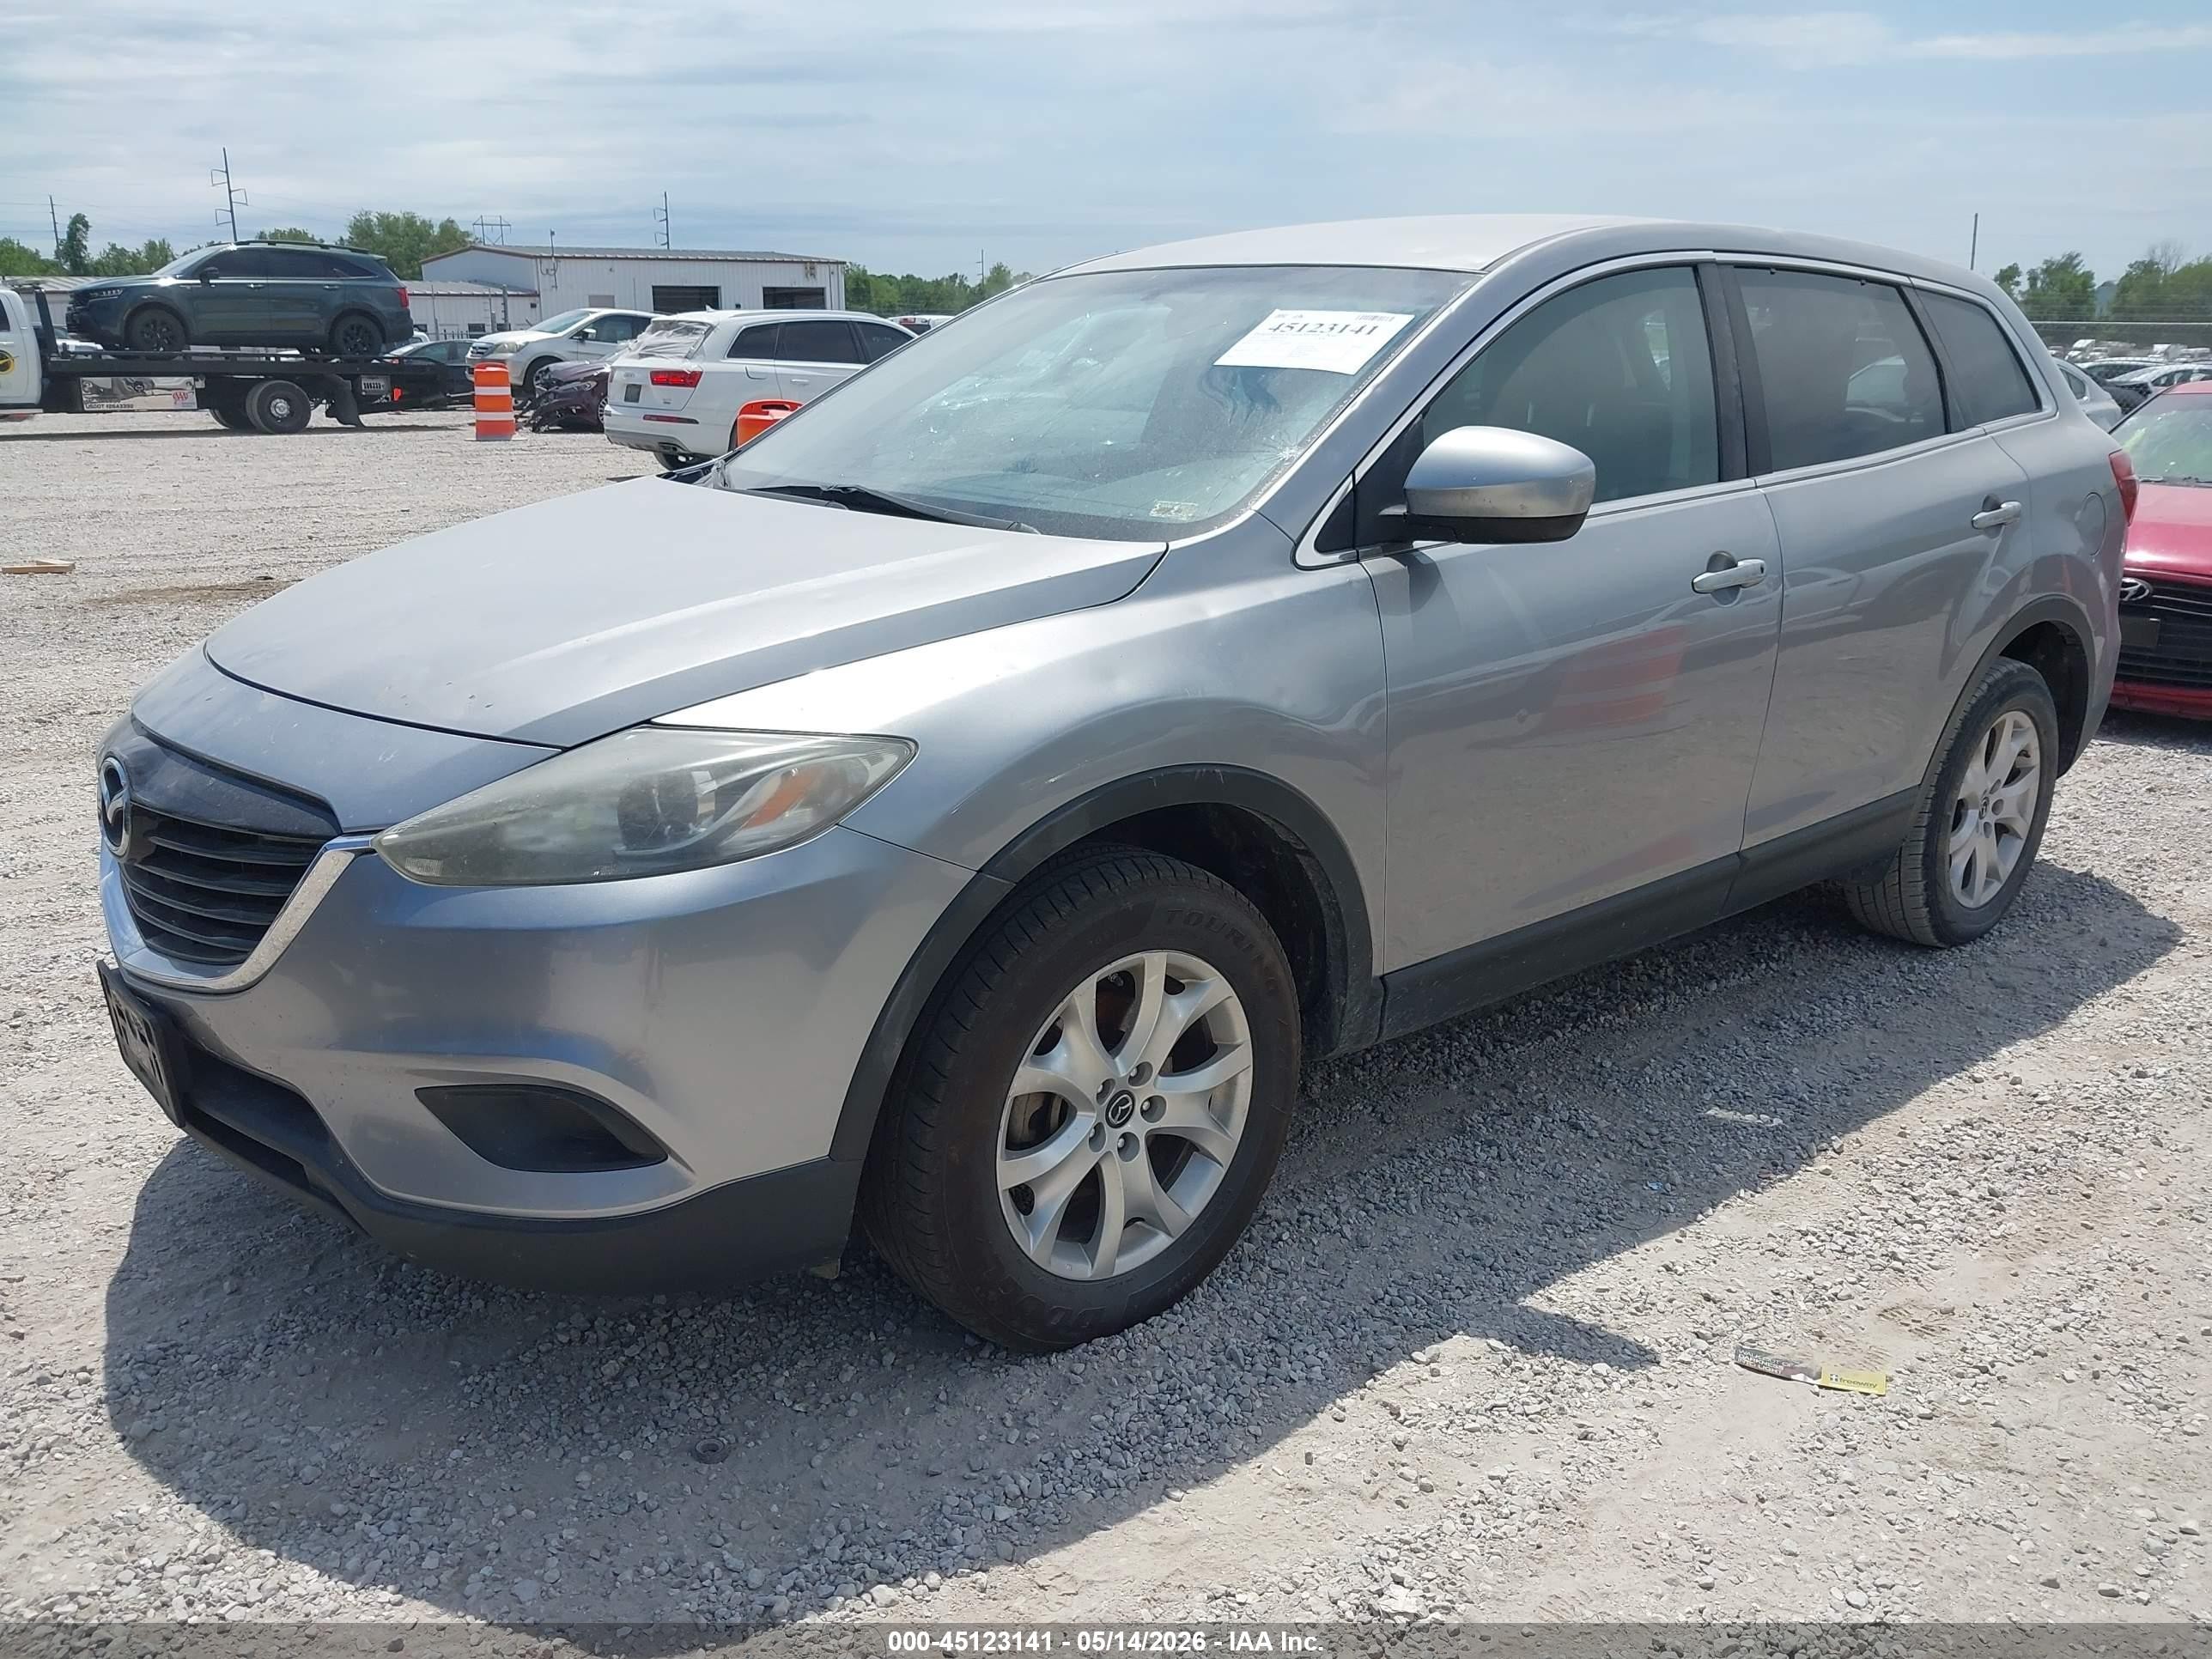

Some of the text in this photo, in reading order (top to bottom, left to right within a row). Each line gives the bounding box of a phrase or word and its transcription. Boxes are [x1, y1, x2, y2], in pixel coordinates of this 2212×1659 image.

[1268, 322, 1378, 335] 45123141
[1738, 1353, 1784, 1370] DARKNESS
[1839, 1377, 1877, 1389] freeway
